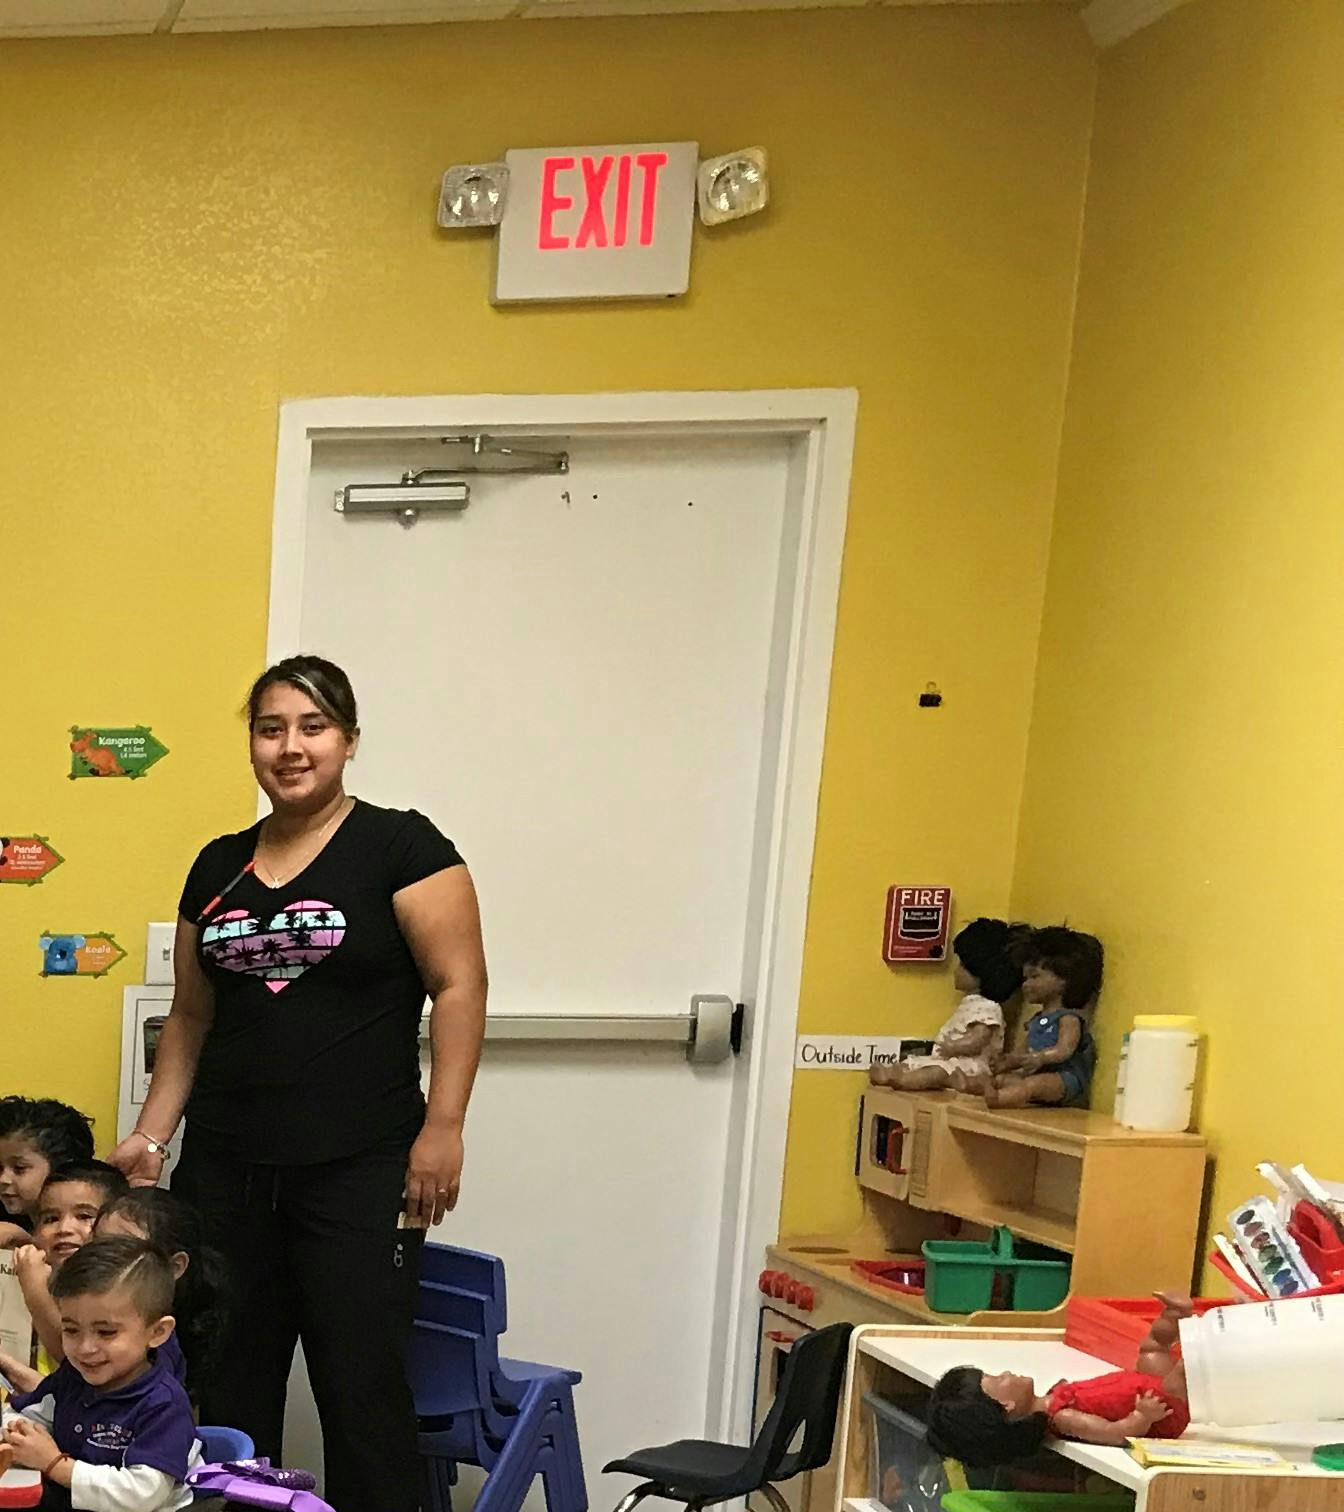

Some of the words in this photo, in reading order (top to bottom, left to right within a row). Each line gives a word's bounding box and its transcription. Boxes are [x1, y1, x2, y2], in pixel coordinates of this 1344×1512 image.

[538, 152, 670, 252] EXIT
[98, 737, 146, 748] Kangaroo
[13, 844, 42, 854] Panda
[901, 890, 945, 905] FIRE
[801, 1043, 862, 1064] Outside
[866, 1044, 898, 1065] Time
